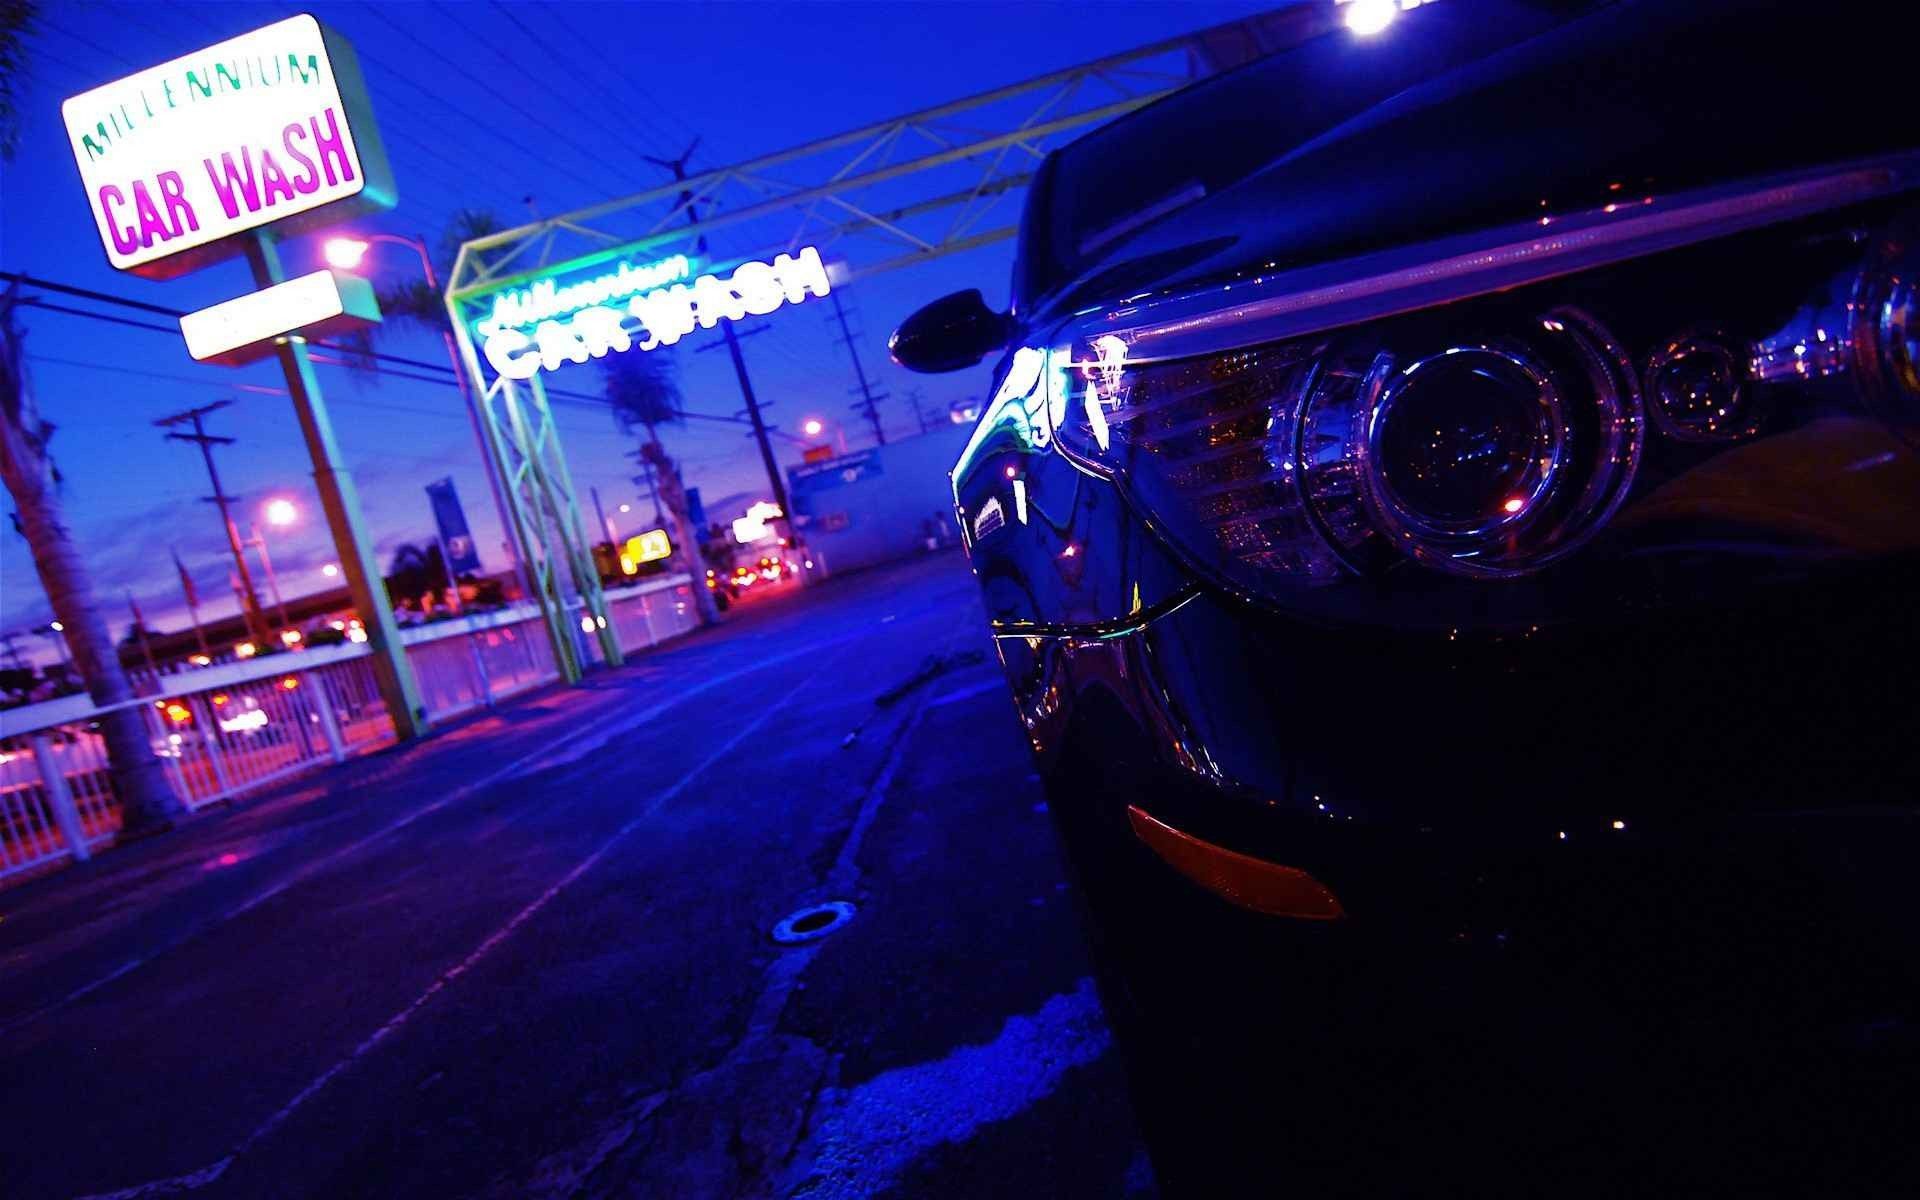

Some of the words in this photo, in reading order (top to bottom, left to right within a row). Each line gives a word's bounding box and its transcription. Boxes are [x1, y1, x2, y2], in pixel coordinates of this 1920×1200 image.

[82, 53, 321, 162] MILLENNIUM
[99, 170, 200, 255] CAR
[203, 107, 355, 219] WASH
[484, 304, 632, 380] CAR
